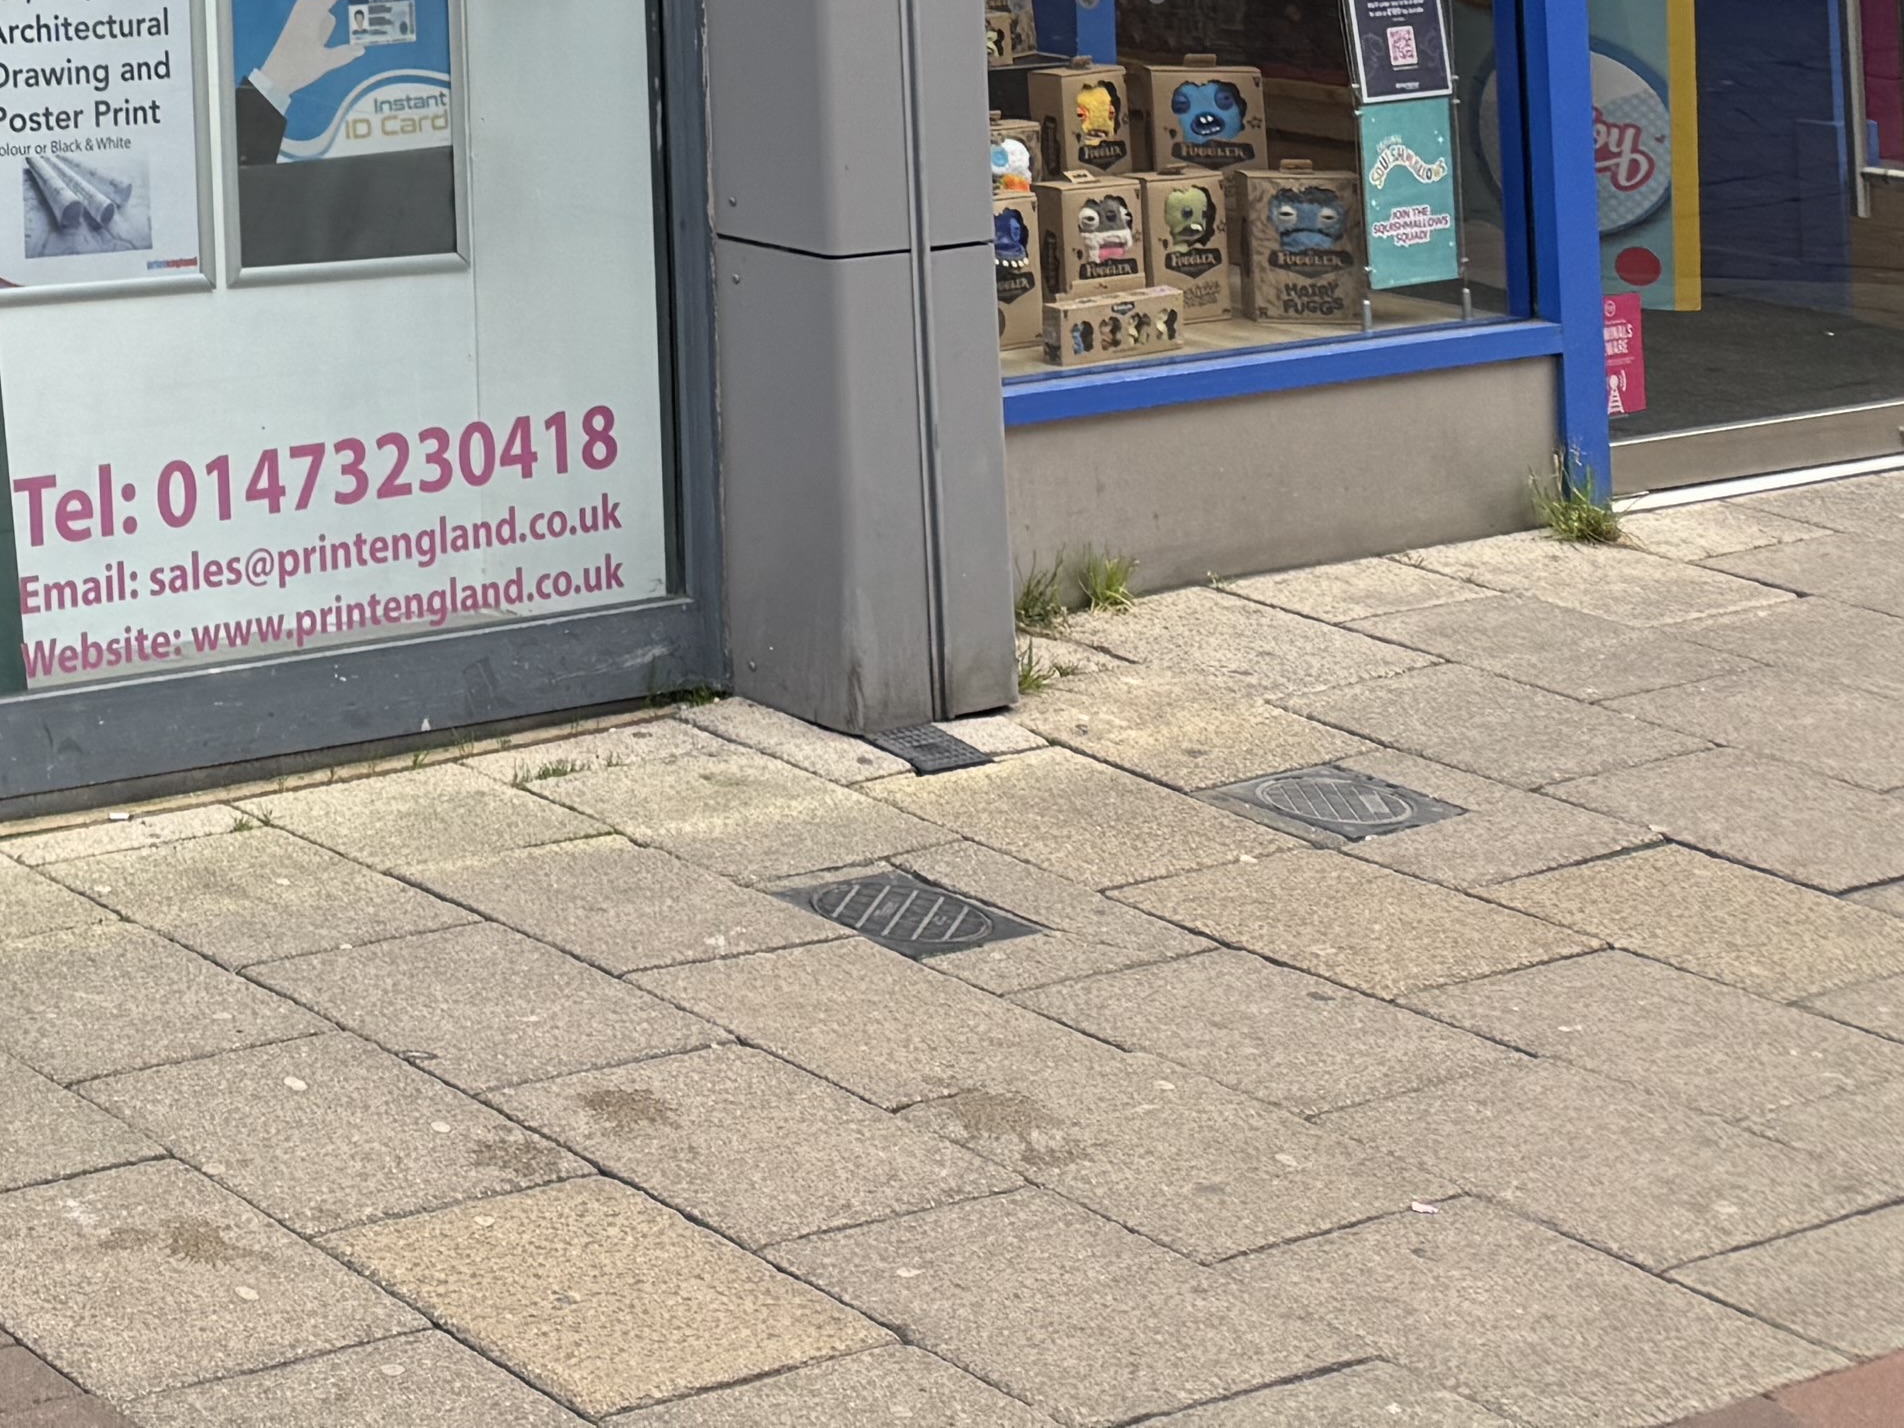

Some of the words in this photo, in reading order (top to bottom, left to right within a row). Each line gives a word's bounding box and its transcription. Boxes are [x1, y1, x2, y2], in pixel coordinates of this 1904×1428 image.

[120, 50, 171, 82] and
[94, 99, 161, 127] Print
[374, 90, 448, 114] Instant
[345, 117, 373, 139] ID
[381, 111, 450, 137] Card
[34, 145, 48, 156] or
[51, 137, 83, 155] Black
[84, 139, 94, 152] &
[96, 136, 132, 151] White
[13, 462, 138, 548] Tel:
[156, 404, 619, 529] 01473230418
[19, 561, 140, 615] Email:
[148, 492, 623, 599] sales@printengland.co.uk
[21, 628, 183, 679] Website:
[191, 553, 625, 655] www.printengland.co.uk
